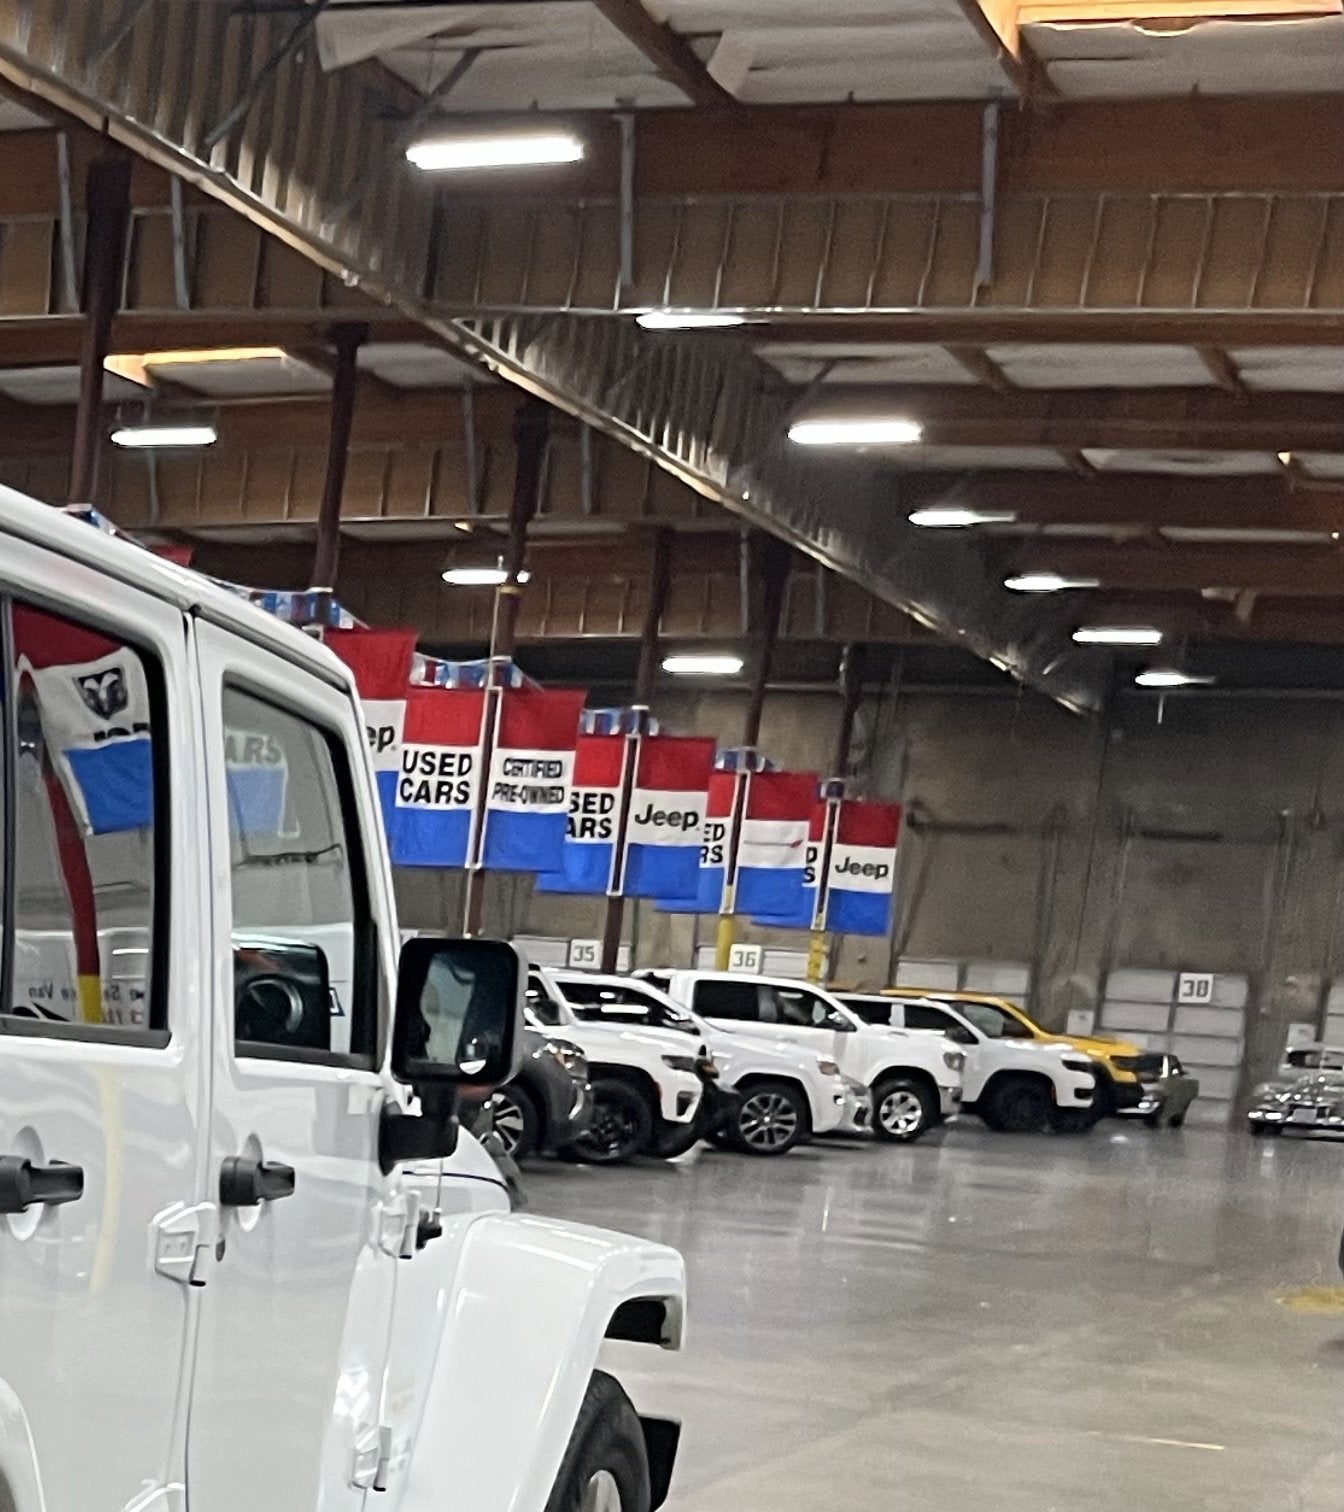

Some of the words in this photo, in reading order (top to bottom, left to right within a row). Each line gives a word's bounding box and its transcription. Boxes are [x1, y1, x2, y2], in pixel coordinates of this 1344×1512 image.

[403, 750, 472, 777] USED
[503, 757, 564, 779] CERTIFIED
[399, 777, 470, 805] CARS
[492, 781, 565, 805] PRE-OWNED
[634, 803, 700, 832] Jeep
[834, 855, 889, 880] Jeep
[573, 944, 595, 963] 35
[732, 950, 757, 968] 36
